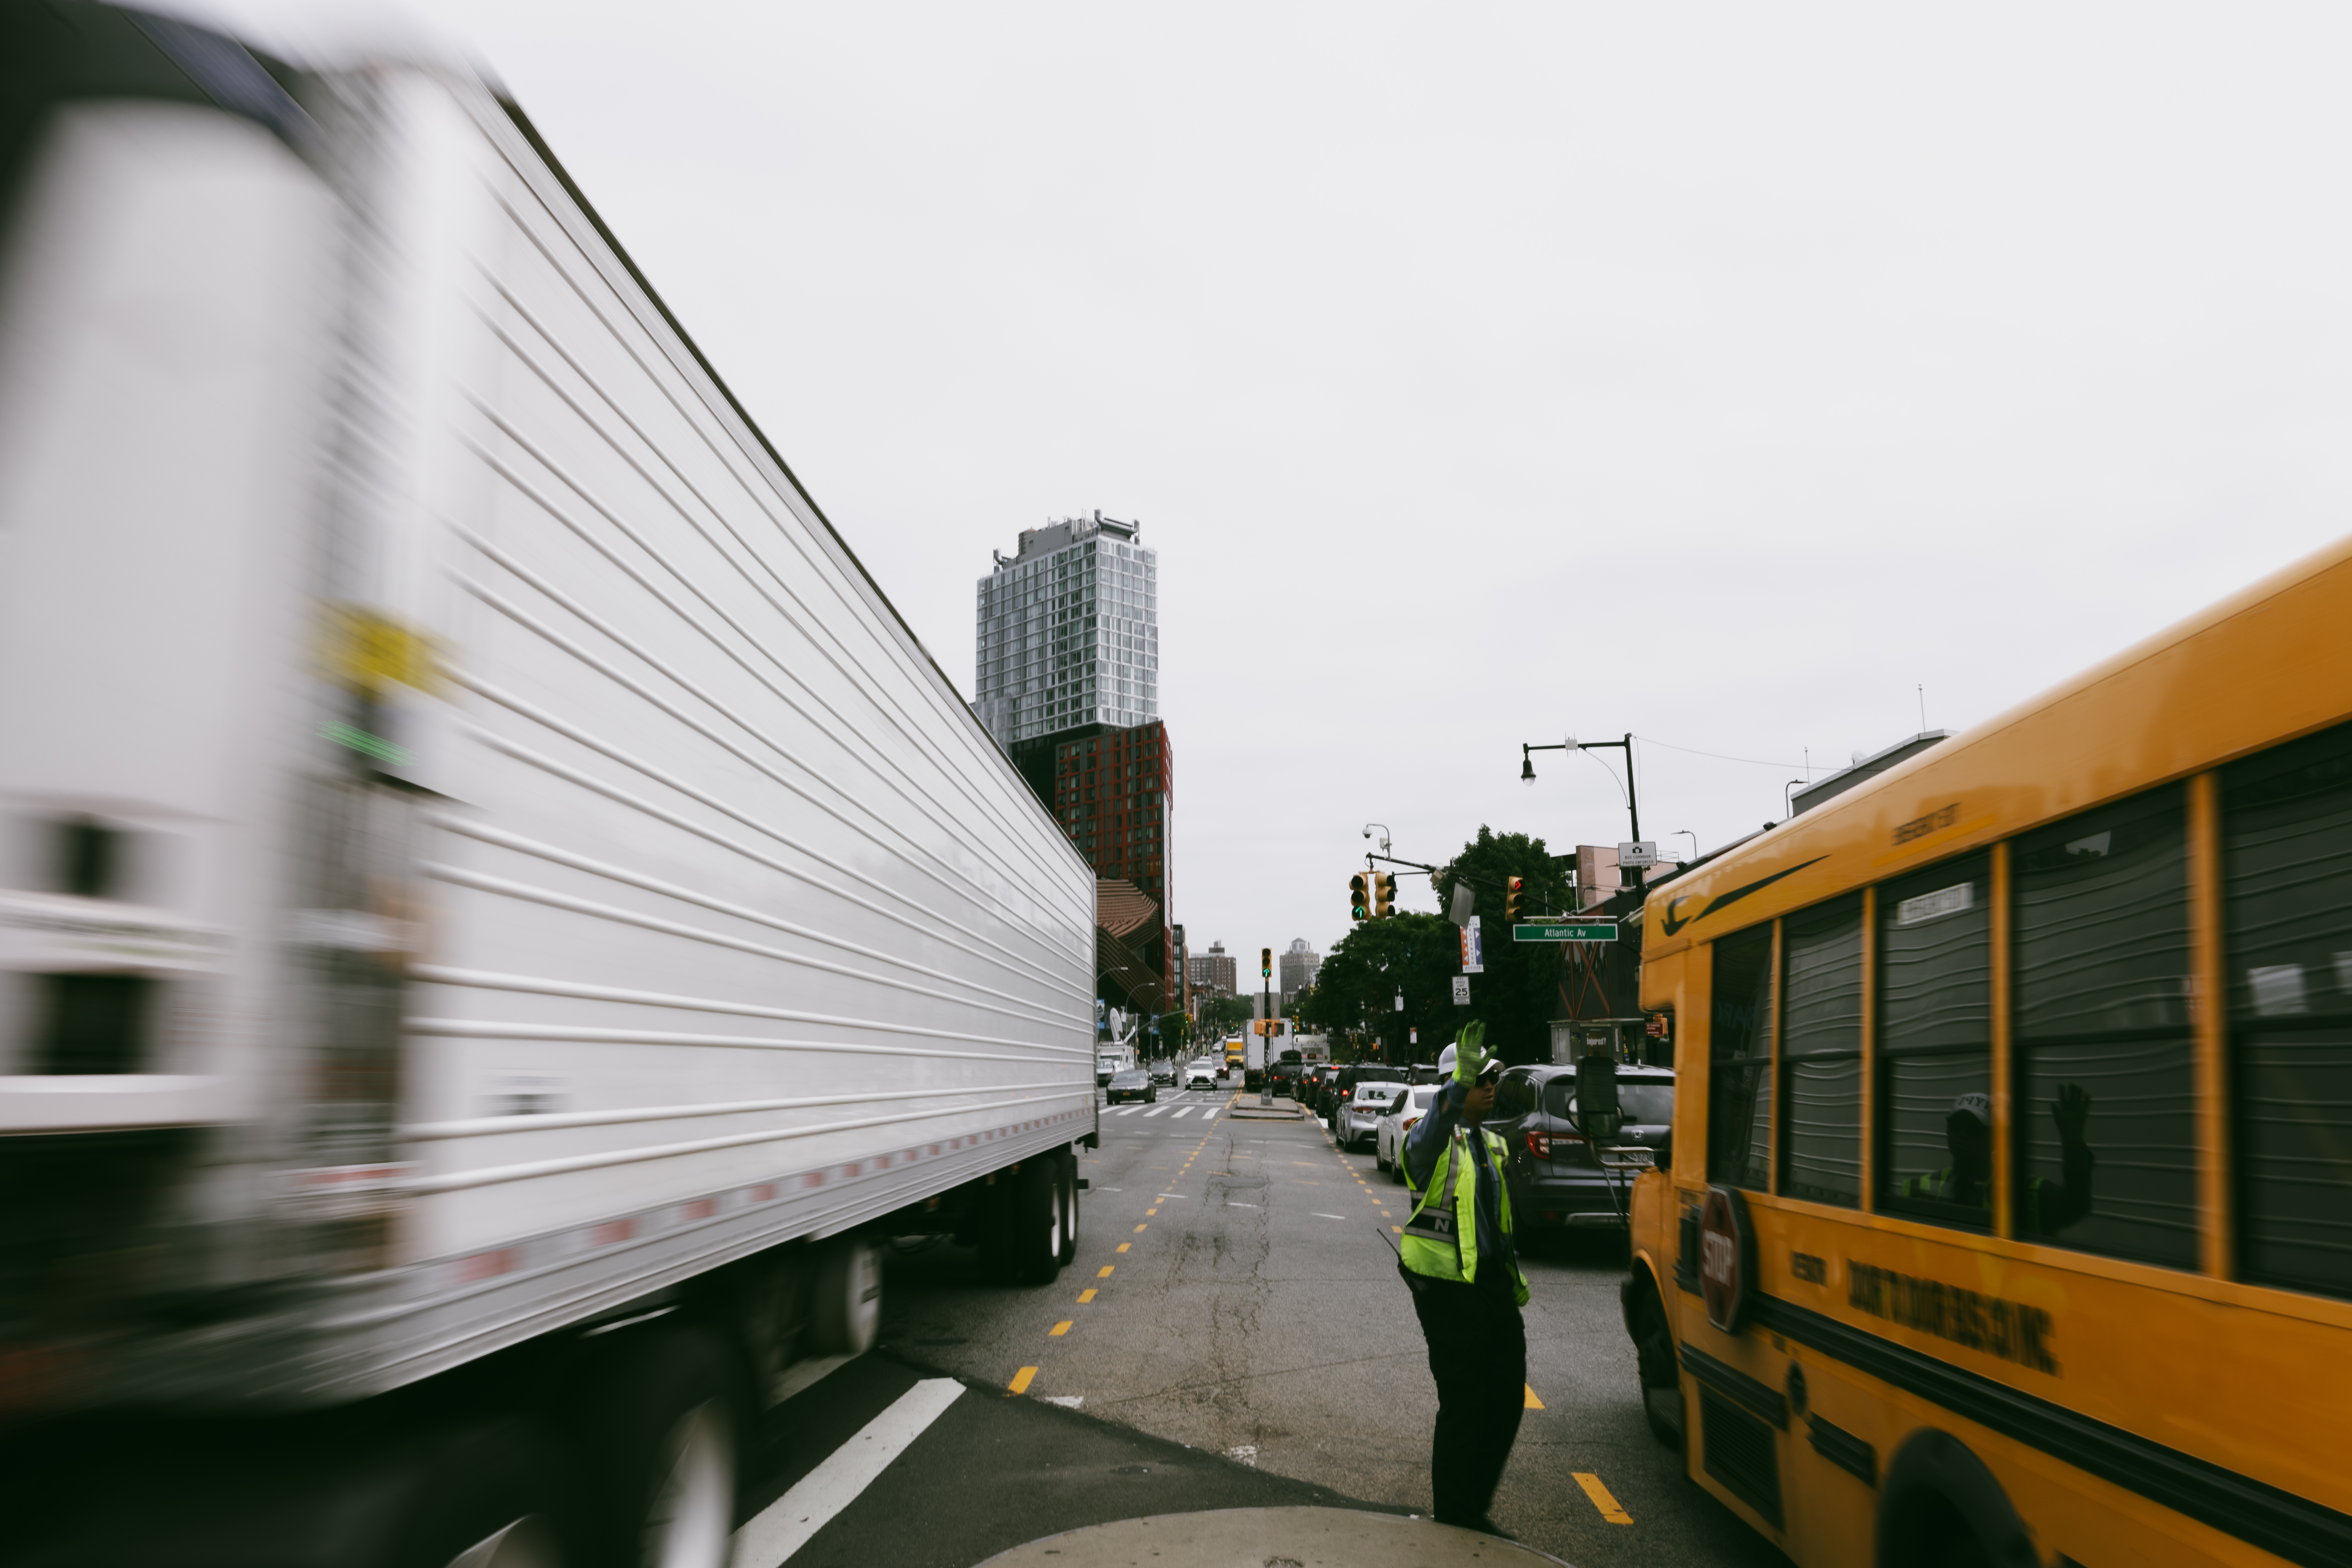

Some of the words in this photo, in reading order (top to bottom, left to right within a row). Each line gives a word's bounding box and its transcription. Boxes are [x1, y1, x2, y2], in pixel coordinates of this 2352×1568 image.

[1544, 928, 1574, 937] Atlantic
[1577, 928, 1586, 937] Av
[1586, 1037, 1606, 1046] Injured?
[1702, 1229, 1734, 1288] STOP
